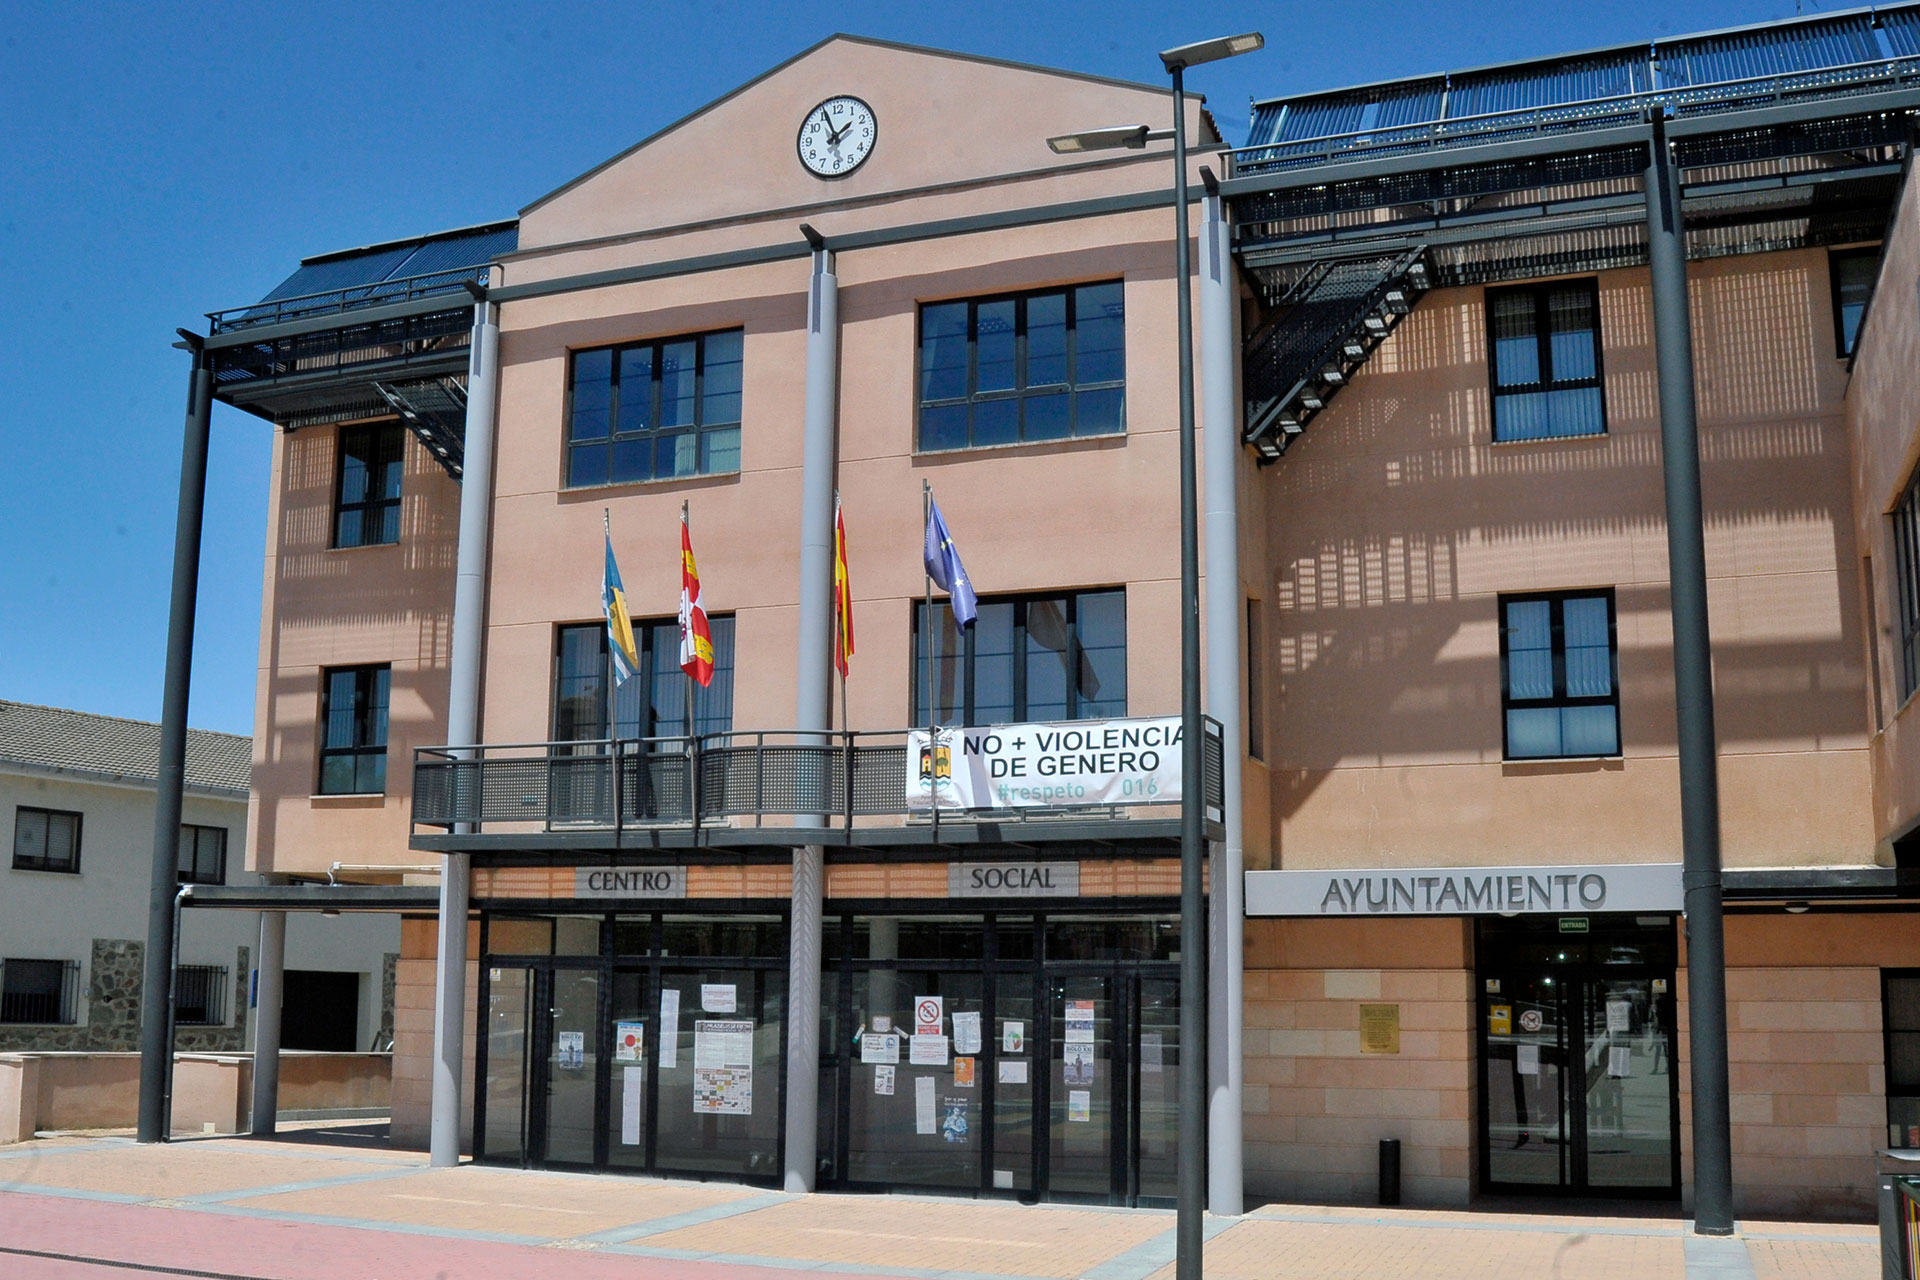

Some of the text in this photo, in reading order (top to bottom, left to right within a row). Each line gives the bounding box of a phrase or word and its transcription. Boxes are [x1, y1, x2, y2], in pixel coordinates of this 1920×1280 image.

[833, 104, 844, 115] 12
[850, 106, 854, 116] 1
[859, 115, 866, 124] 2
[810, 123, 821, 133] 10
[863, 127, 869, 138] 3
[805, 137, 812, 147] 9
[857, 142, 864, 152] 4
[809, 149, 817, 159] 8
[847, 154, 854, 164] 5
[819, 158, 826, 168] 7
[833, 160, 840, 170] 6
[963, 735, 1003, 756] NO
[1012, 736, 1026, 751] +
[991, 751, 1160, 778] DE GENERO
[997, 777, 1159, 803] #respeto 016
[588, 871, 671, 892] CENTRO
[970, 867, 1056, 889] SOCIAL
[1321, 874, 1607, 911] AYUNTAMIENTO
[1561, 921, 1586, 929] ENTRADA
